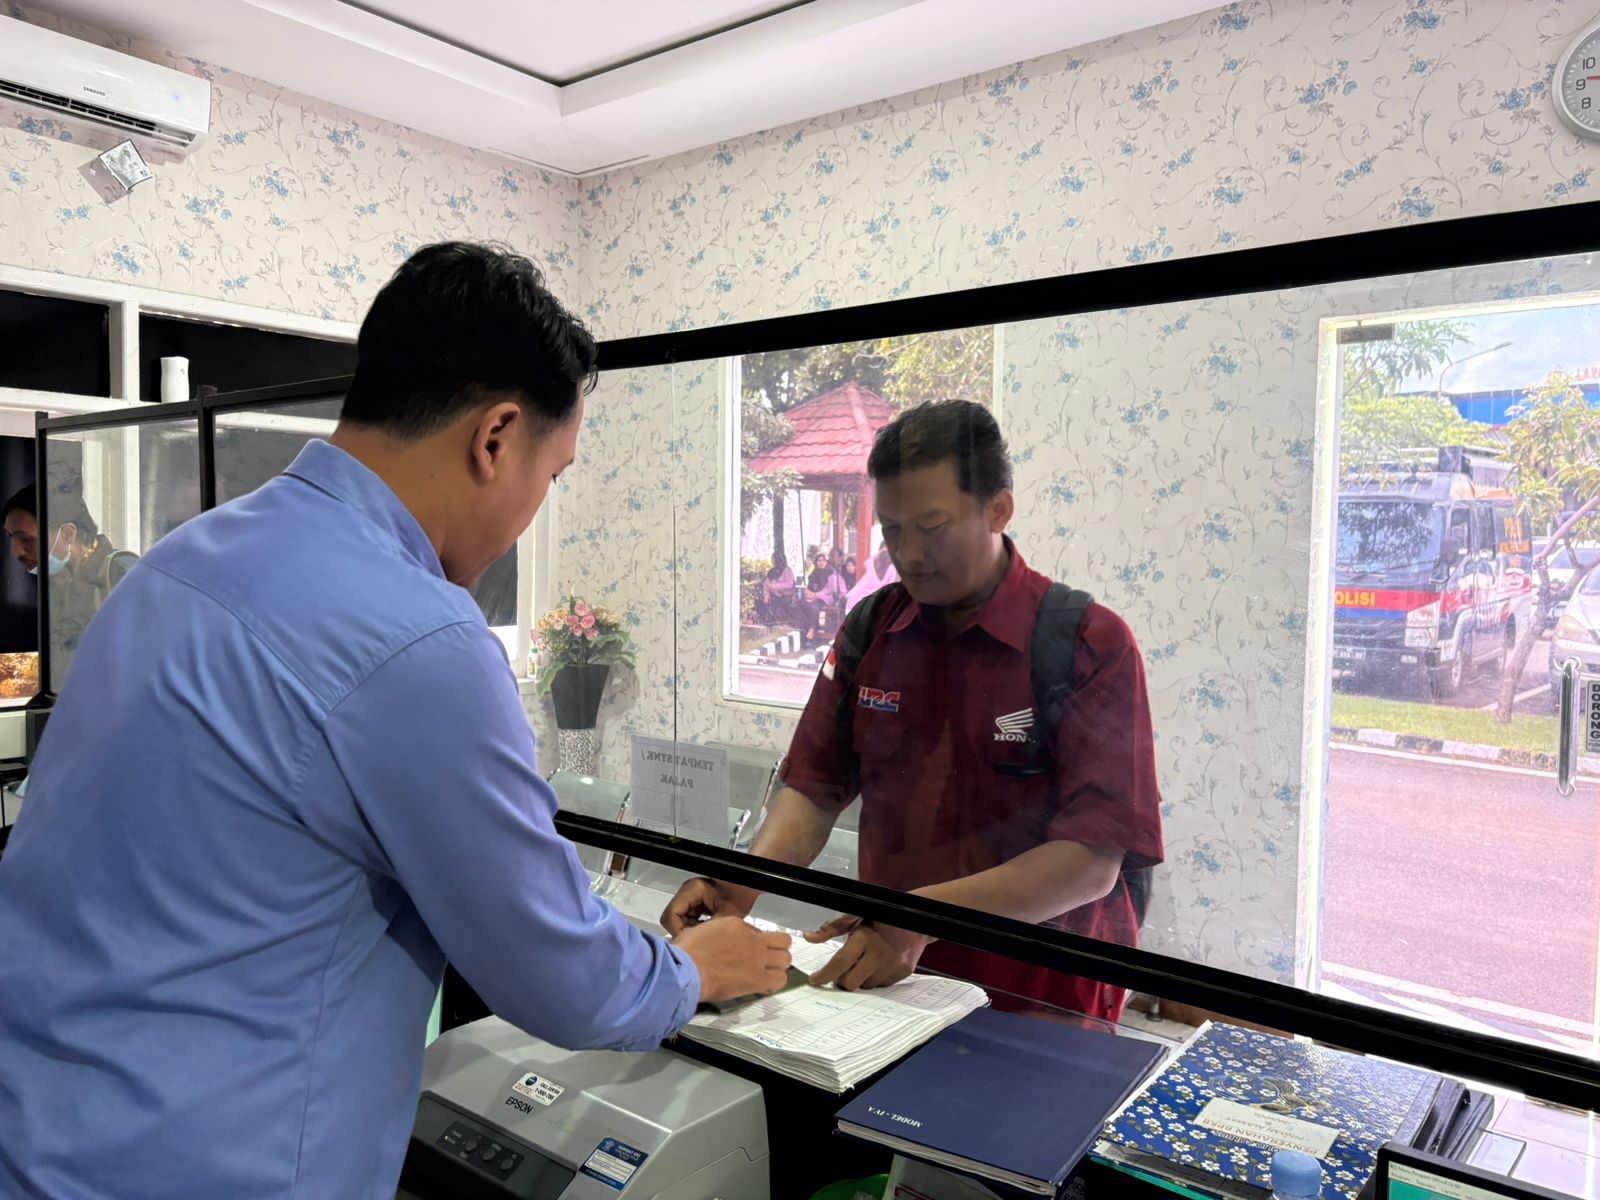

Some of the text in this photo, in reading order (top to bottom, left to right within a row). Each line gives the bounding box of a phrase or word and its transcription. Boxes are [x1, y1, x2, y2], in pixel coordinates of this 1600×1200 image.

[1583, 57, 1596, 70] 10
[1576, 79, 1586, 91] 9
[1582, 97, 1592, 110] 8
[1335, 591, 1376, 607] OLISI
[993, 732, 1036, 743] HON
[504, 1096, 533, 1114] EPSON
